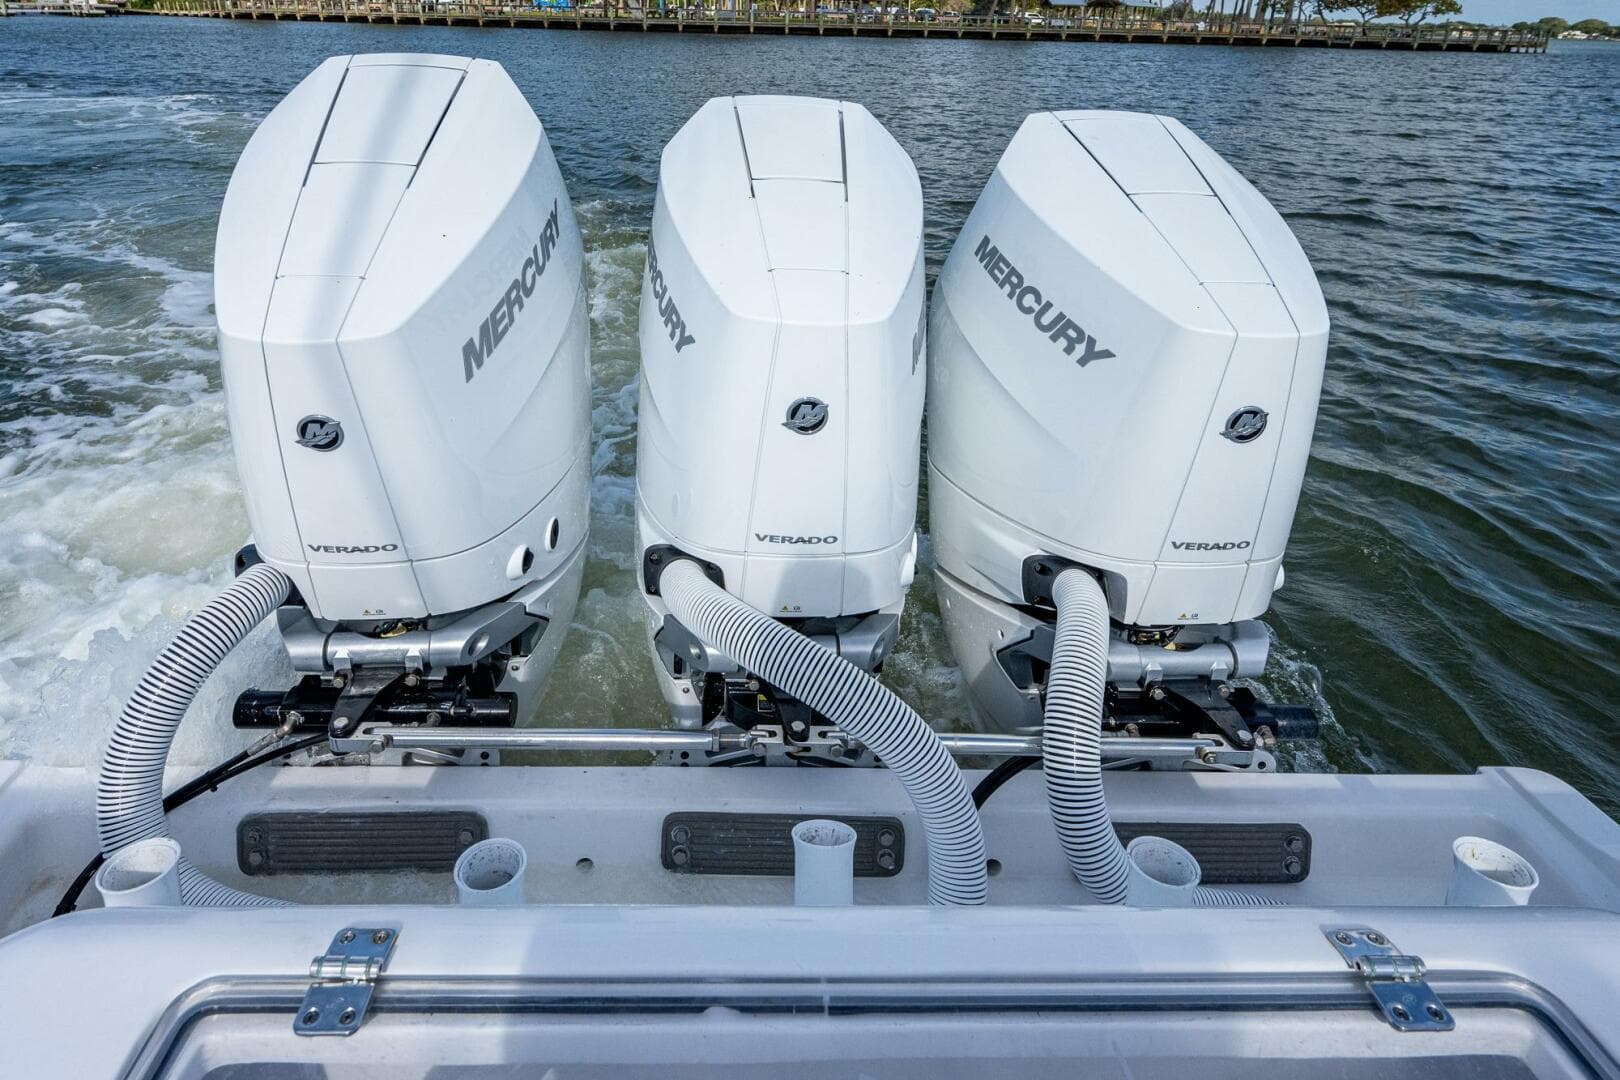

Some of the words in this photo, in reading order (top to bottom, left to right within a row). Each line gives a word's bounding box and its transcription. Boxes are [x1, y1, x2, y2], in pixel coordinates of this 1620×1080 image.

[462, 197, 560, 384] MERCURY
[974, 234, 1117, 368] MERCURY
[754, 533, 839, 545] VERADO
[307, 543, 399, 554] VERADO
[1171, 540, 1251, 551] VERADO
